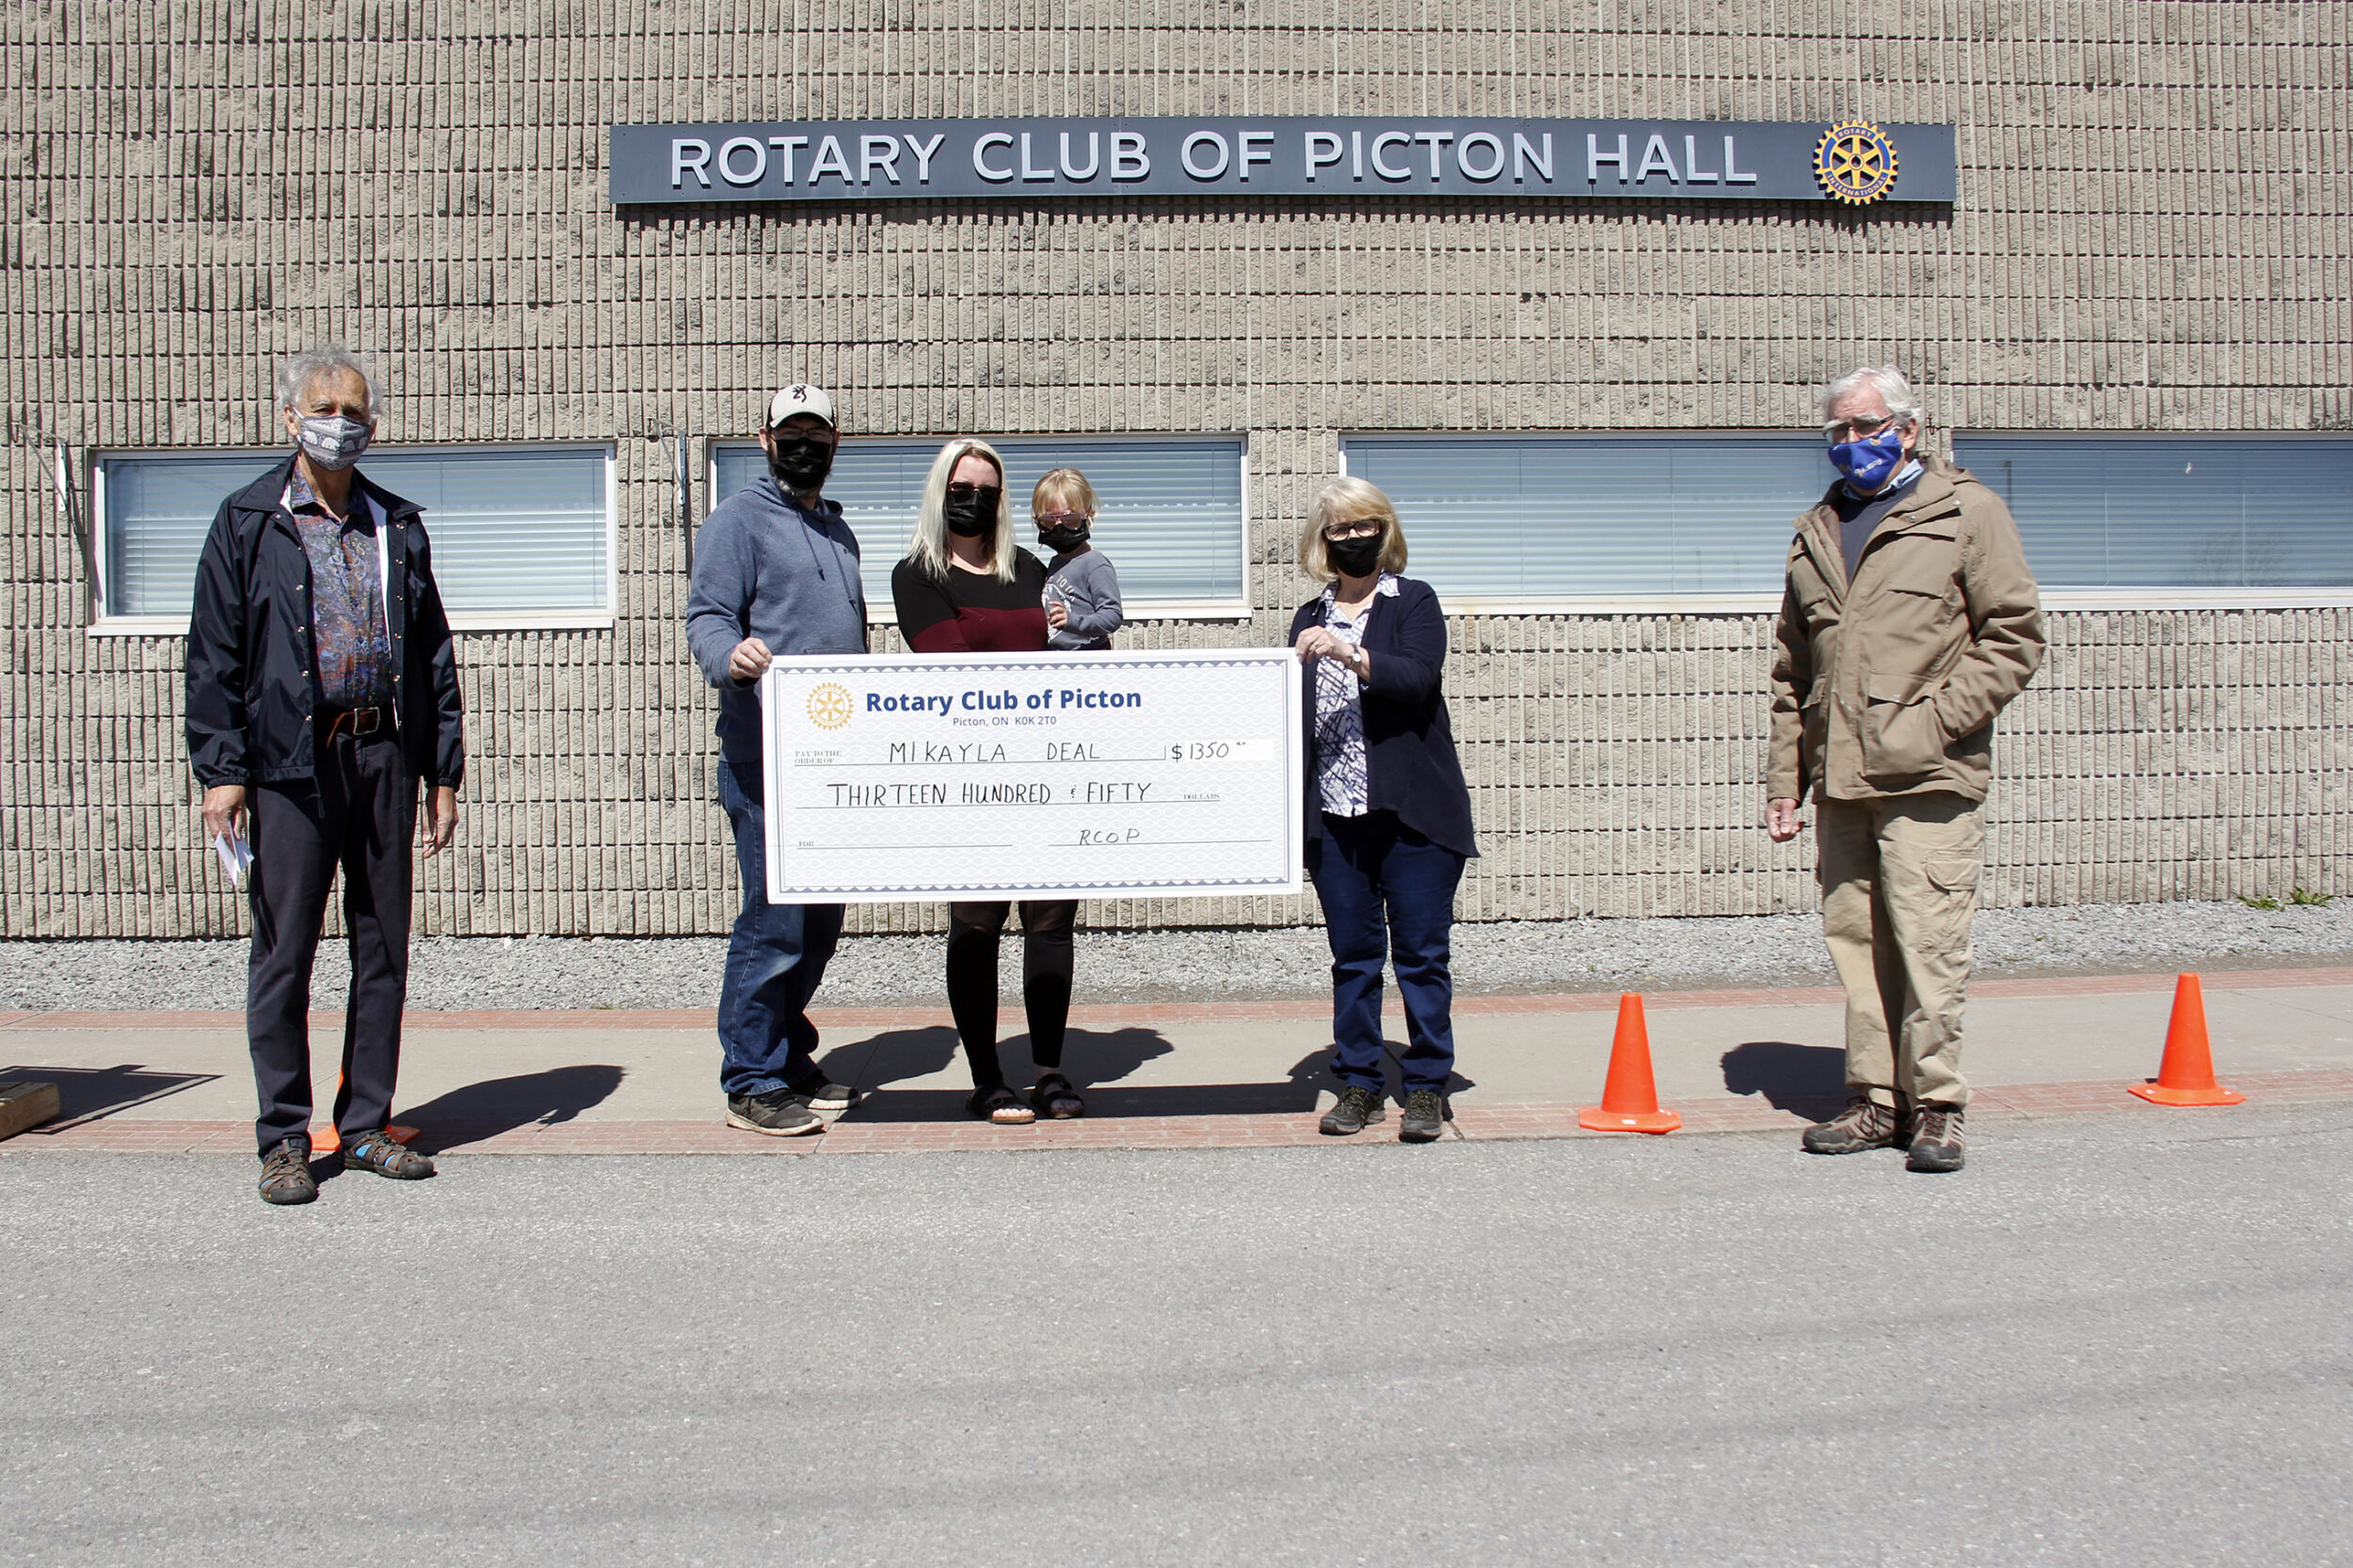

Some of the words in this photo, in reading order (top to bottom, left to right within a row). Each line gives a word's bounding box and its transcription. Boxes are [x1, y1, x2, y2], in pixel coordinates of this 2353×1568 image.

[1837, 128, 1872, 138] ROTARY
[671, 134, 944, 187] ROTARY
[972, 132, 1150, 180] CLUB
[1181, 131, 1274, 182] OF
[1305, 131, 1552, 183] PICTON
[1587, 134, 1757, 184] HALL
[1827, 174, 1886, 197] INTERNATIONAL
[867, 693, 952, 716] Rotary
[961, 690, 1018, 711] Club
[1026, 689, 1052, 710] of
[1060, 688, 1142, 709] Picton
[952, 716, 989, 728] Picton,
[991, 716, 1009, 726] ON
[889, 741, 1006, 763] MIKAYLA
[1047, 742, 1100, 761] DEAL
[826, 783, 946, 807] THIRTEEN
[962, 782, 1050, 805] HUNDRED
[1087, 782, 1151, 803] FIFTY
